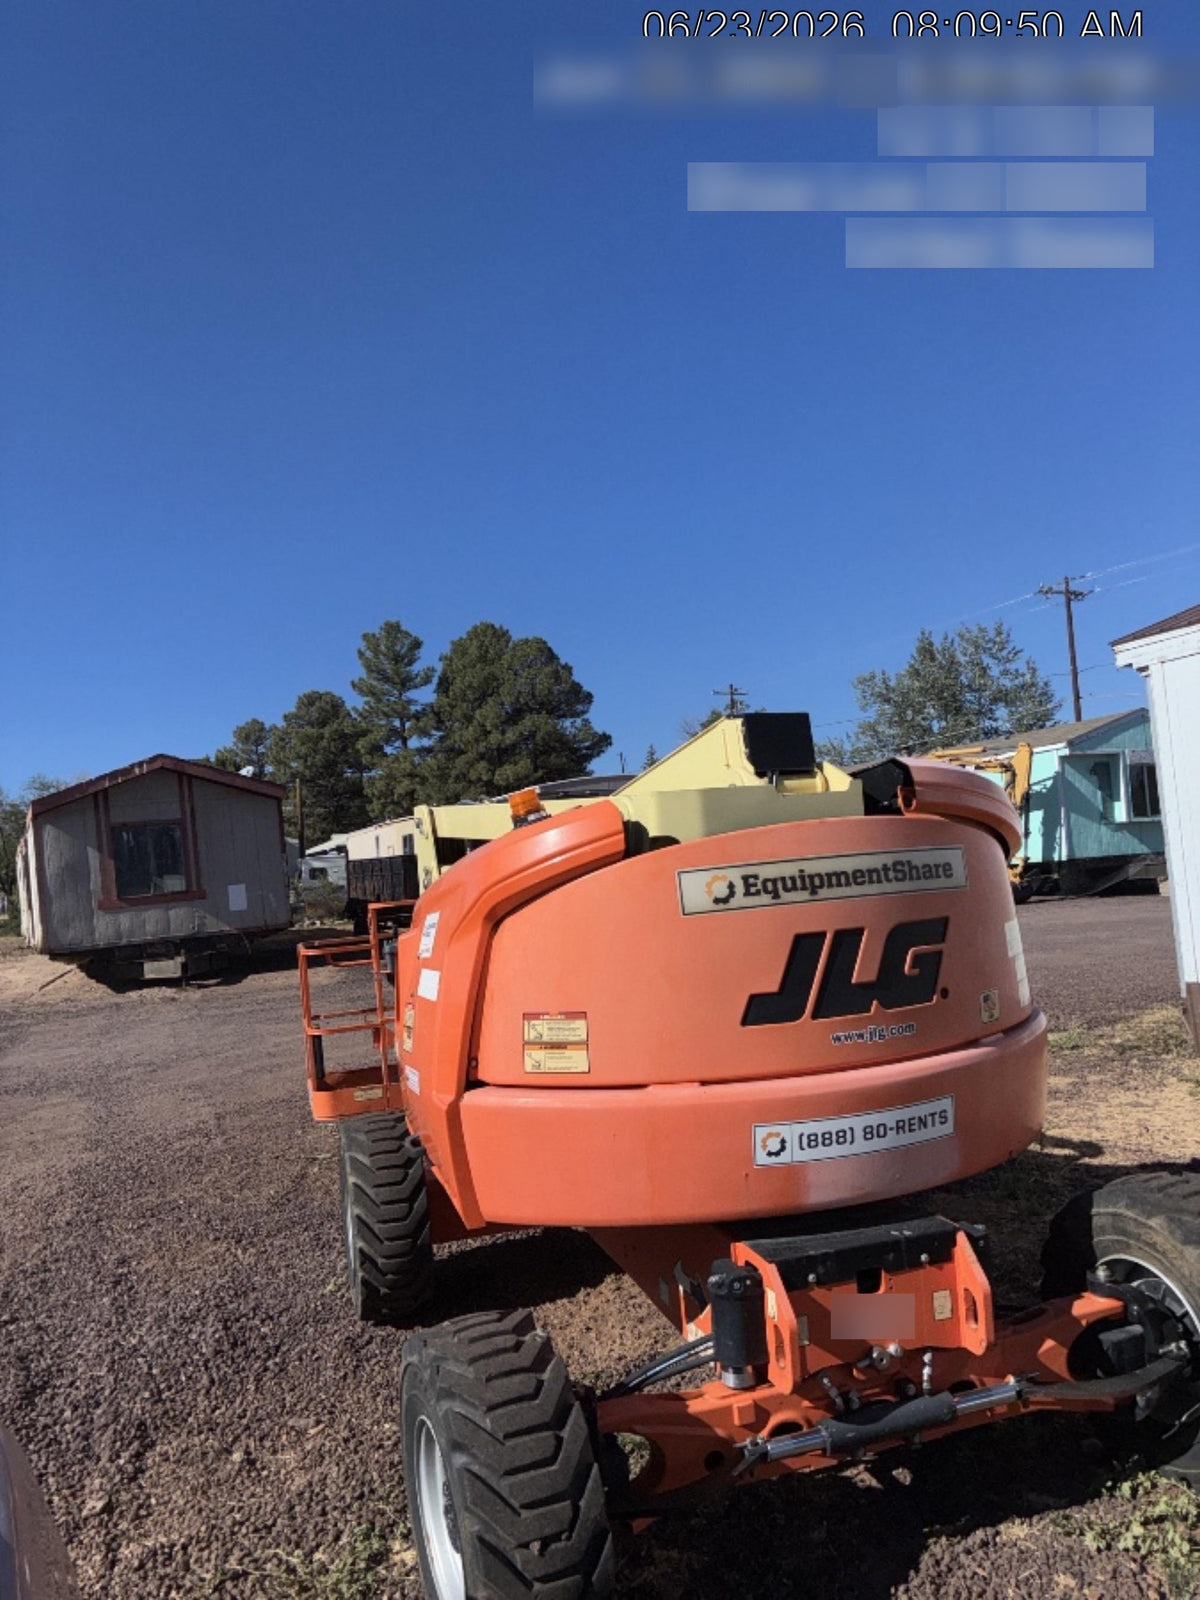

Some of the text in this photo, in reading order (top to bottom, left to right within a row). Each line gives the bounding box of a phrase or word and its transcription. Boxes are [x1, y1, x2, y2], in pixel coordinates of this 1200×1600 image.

[741, 859, 954, 899] EquipmentShare
[831, 1023, 916, 1045] www.jlg.com
[798, 1109, 949, 1151] (888) 80-RENTS
